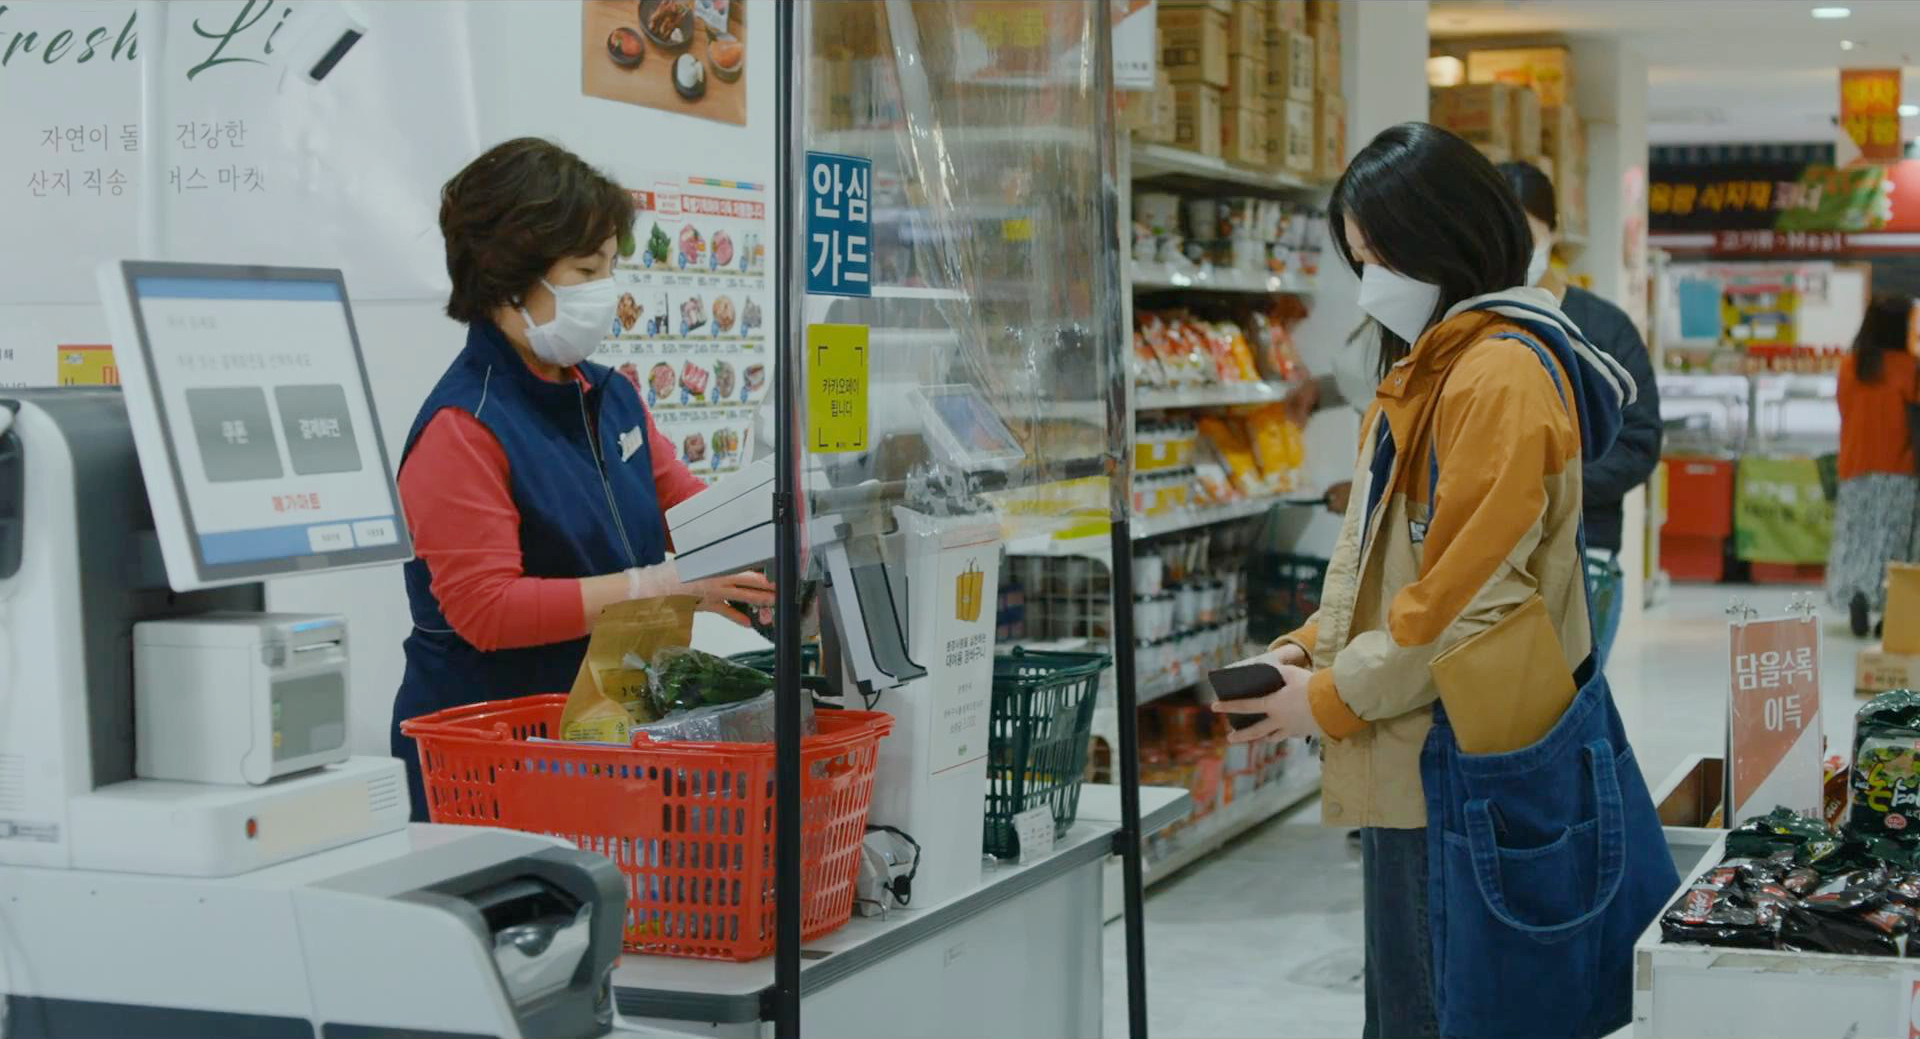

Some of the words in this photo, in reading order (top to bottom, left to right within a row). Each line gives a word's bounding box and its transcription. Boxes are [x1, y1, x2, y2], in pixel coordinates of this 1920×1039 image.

[0, 5, 138, 68] resh
[40, 124, 108, 152] 자연이
[120, 124, 138, 152] 돌
[176, 119, 247, 149] 건강한
[27, 169, 71, 197] 산지
[82, 167, 127, 196] 직송
[812, 163, 869, 223] 안심
[811, 230, 869, 286] 가드
[823, 378, 859, 396] 카카오페이
[1736, 646, 1813, 690] 담을수록
[1764, 694, 1802, 732] 이득
